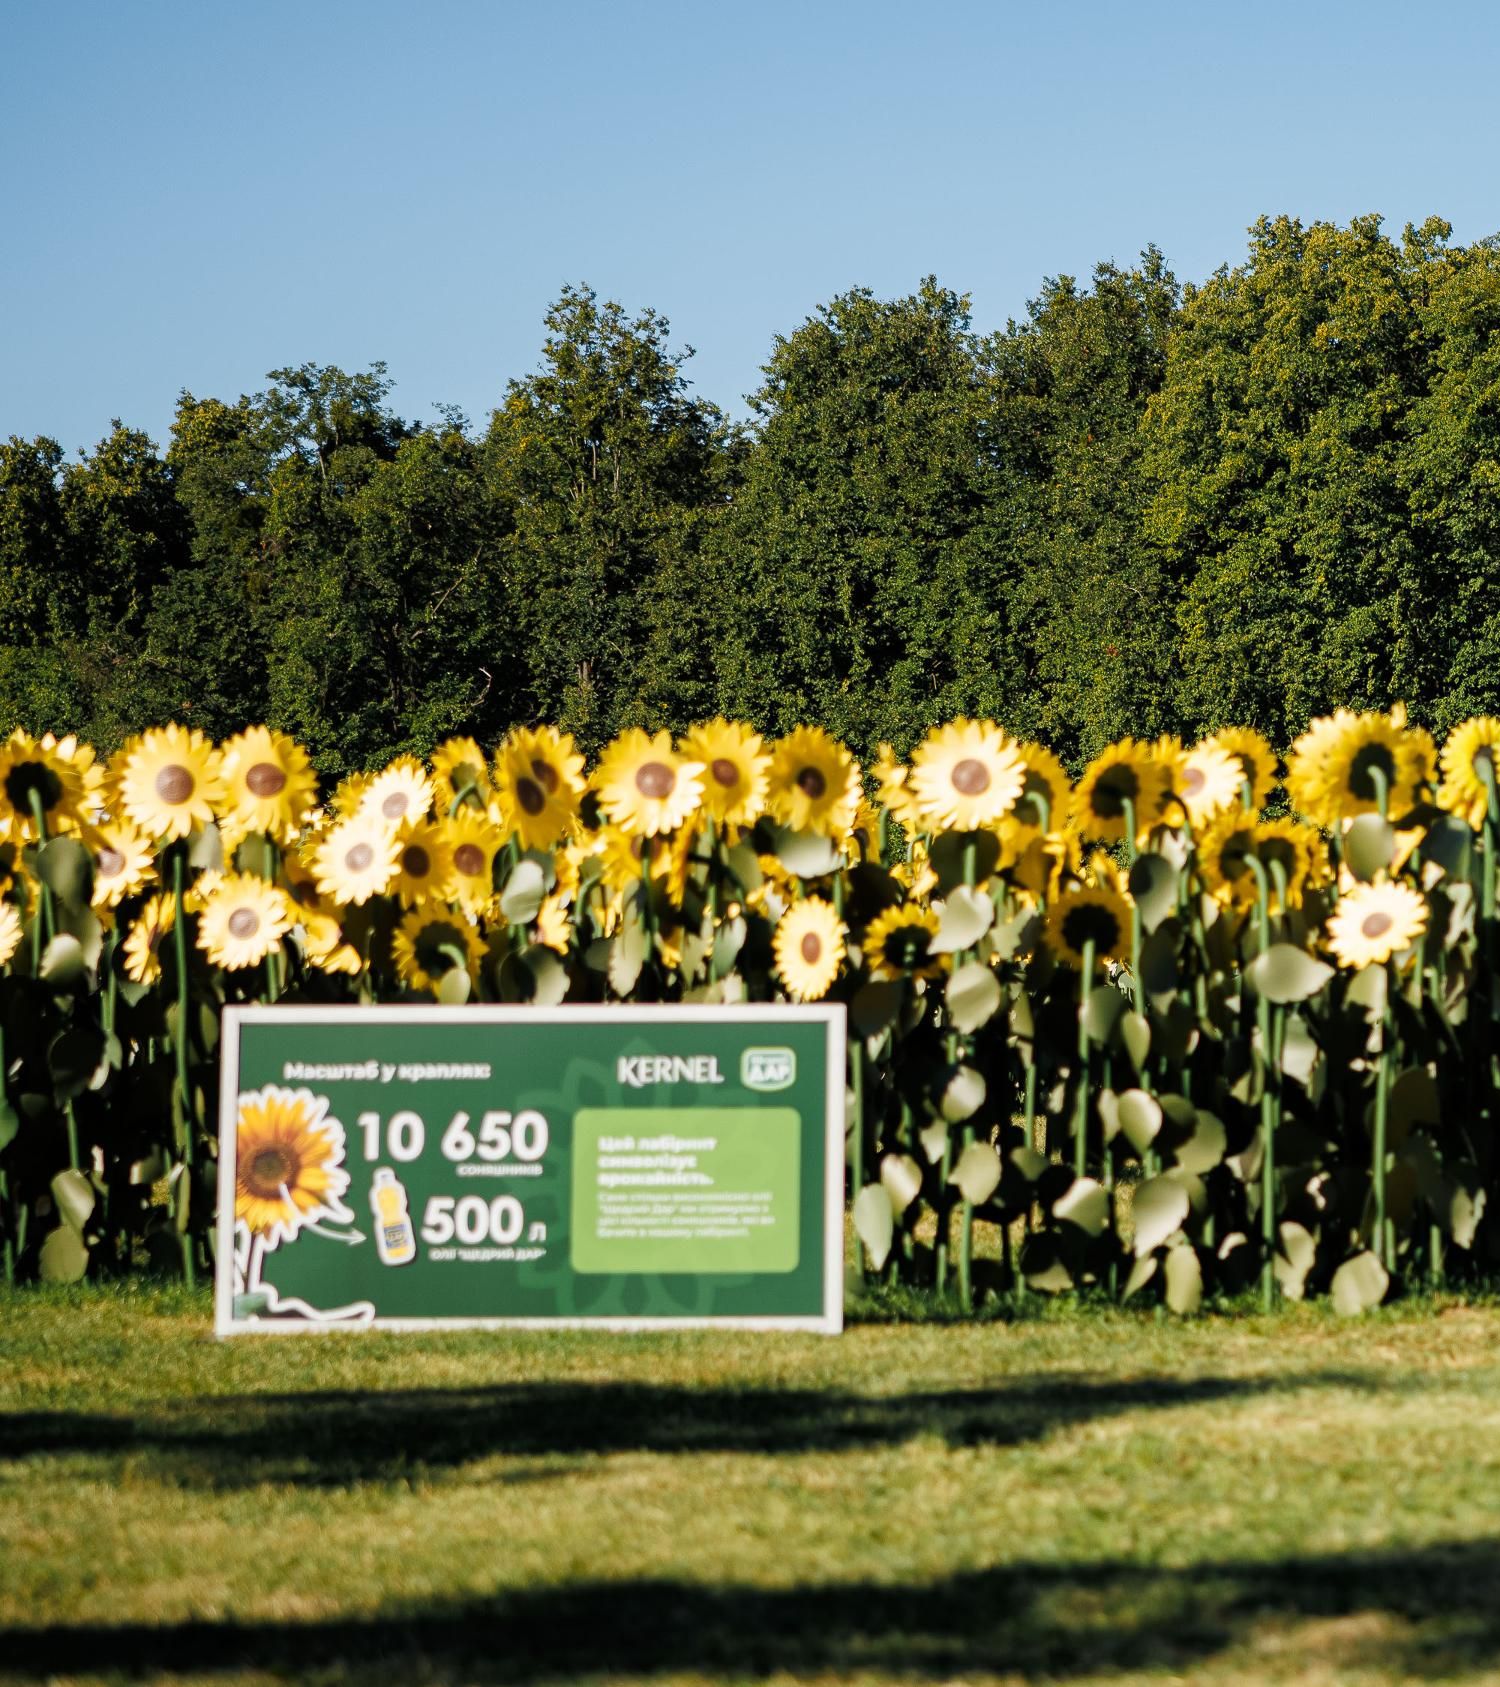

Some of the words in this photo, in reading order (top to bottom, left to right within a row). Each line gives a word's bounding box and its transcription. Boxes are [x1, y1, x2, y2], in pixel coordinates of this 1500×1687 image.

[283, 1060, 379, 1080] Масштаб
[380, 1063, 396, 1083] у
[398, 1062, 492, 1082] краплях:
[617, 1055, 725, 1088] KERNEL
[357, 1110, 426, 1162] 10
[441, 1110, 549, 1162] 650
[420, 1194, 524, 1245] 500
